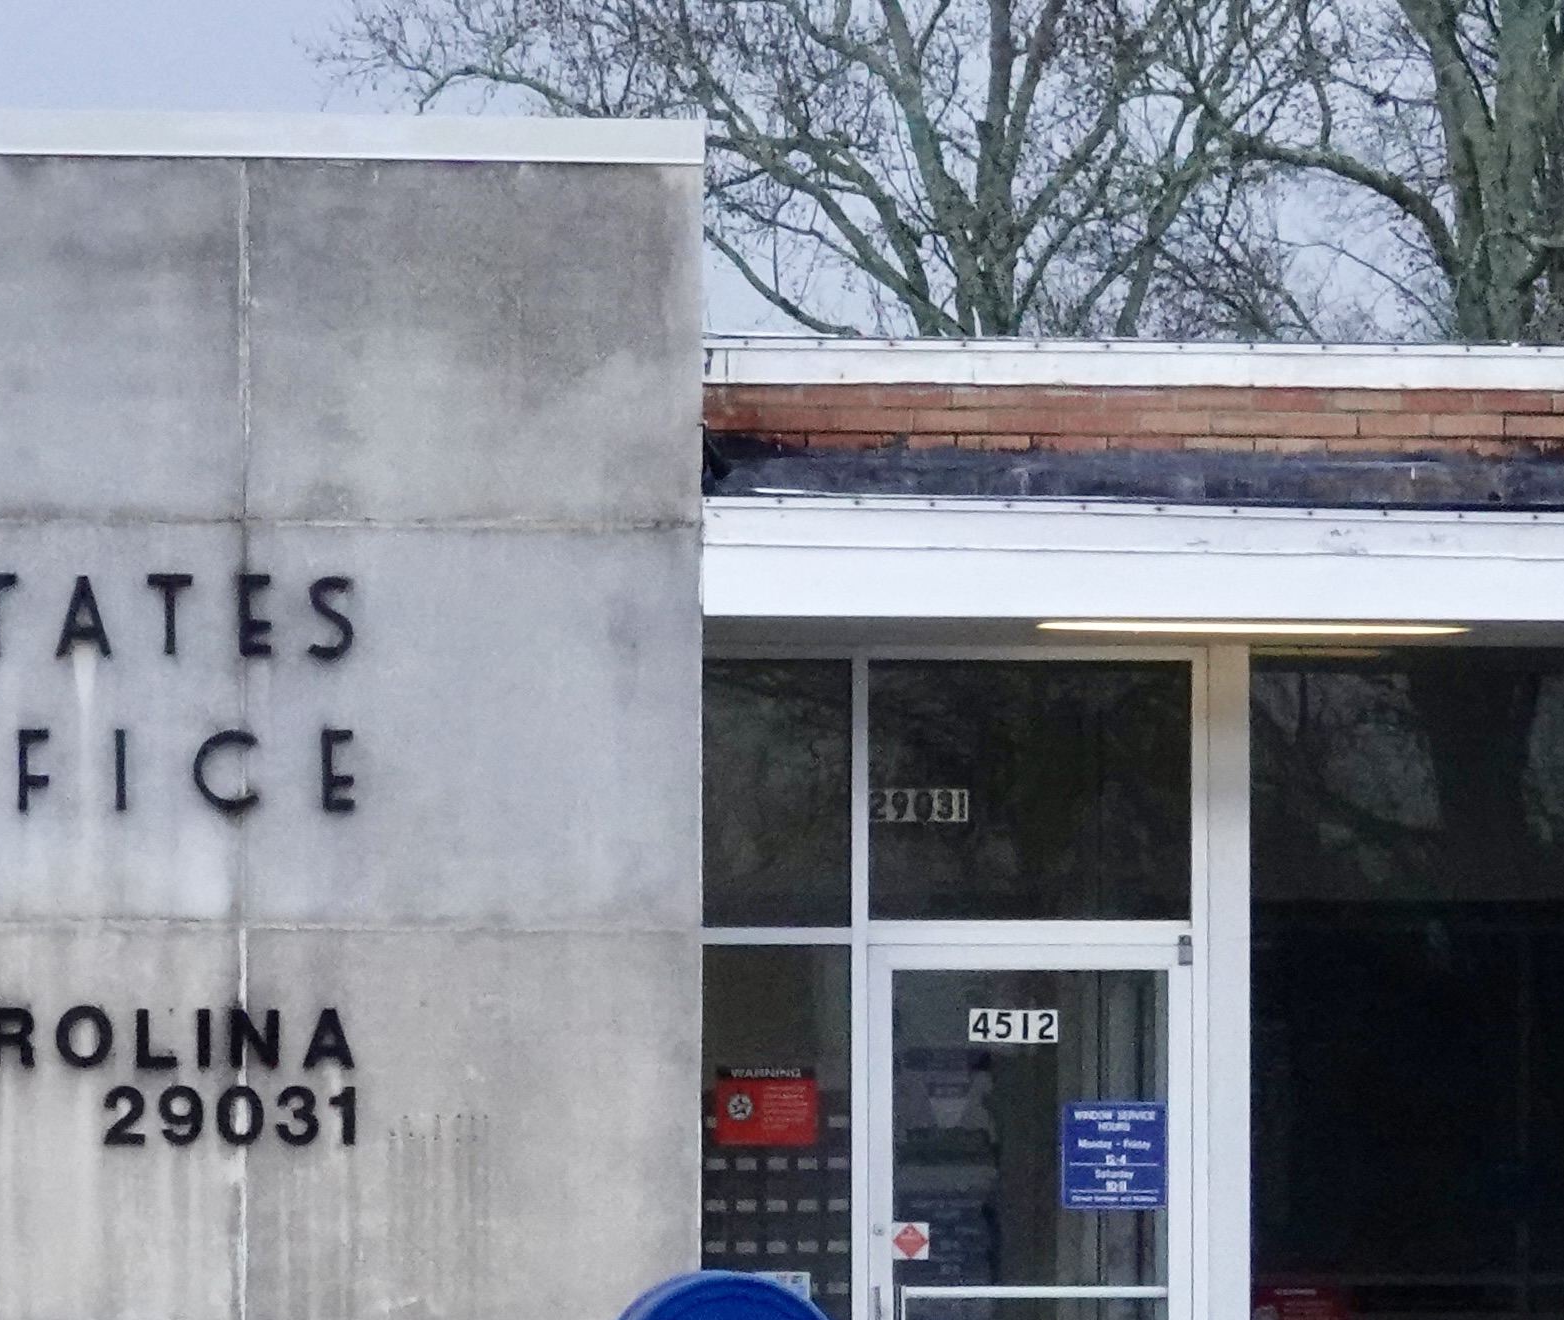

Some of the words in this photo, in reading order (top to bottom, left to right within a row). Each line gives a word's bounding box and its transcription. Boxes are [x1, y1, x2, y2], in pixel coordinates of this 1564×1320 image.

[869, 790, 965, 819] 29031
[972, 1012, 1054, 1040] 4512
[731, 1068, 801, 1078] WARNING
[102, 1084, 358, 1147] 29031
[1074, 1110, 1113, 1121] WINDOW
[1117, 1110, 1156, 1121] SERVICE
[1077, 1138, 1113, 1150] Monday
[1122, 1138, 1152, 1151] Friday
[1095, 1169, 1134, 1180] Saturday
